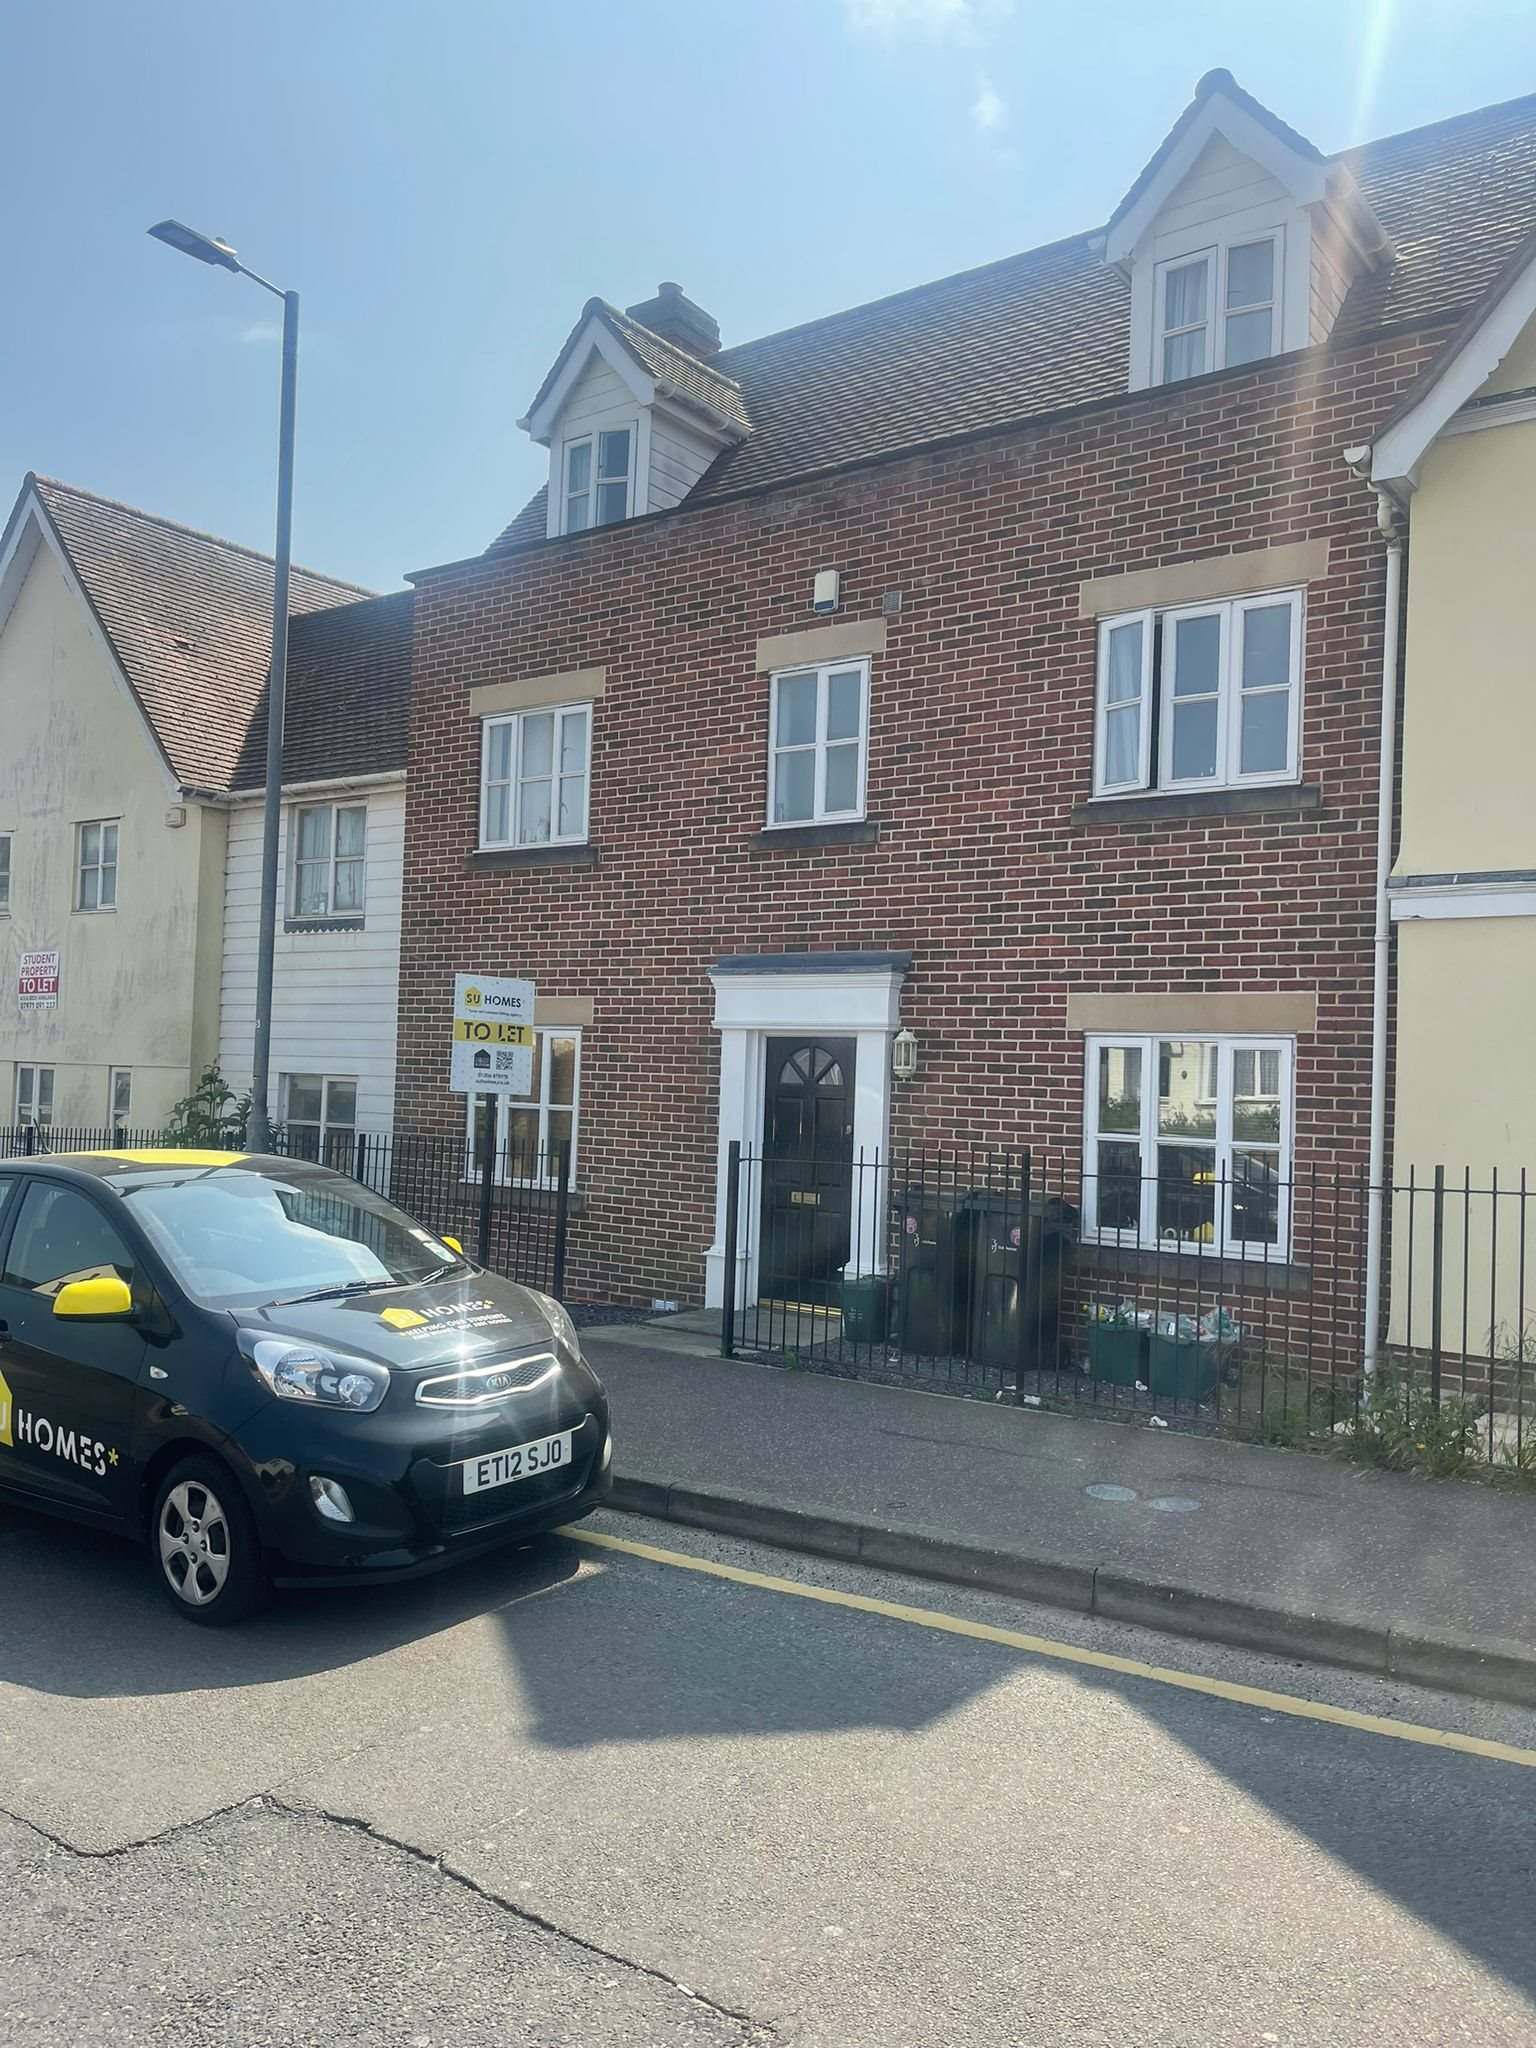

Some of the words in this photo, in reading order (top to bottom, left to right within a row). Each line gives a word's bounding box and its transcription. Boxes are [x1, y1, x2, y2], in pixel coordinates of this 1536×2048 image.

[24, 954, 56, 965] STUDENT
[21, 966, 57, 976] PROPERTY
[22, 979, 35, 993] TO
[37, 978, 55, 992] LET
[466, 993, 480, 1004] SU
[484, 996, 522, 1008] HOMES
[463, 1021, 491, 1041] TO
[498, 1024, 525, 1043] LET
[490, 1375, 509, 1388] KIA
[477, 1451, 522, 1487] ET12
[527, 1439, 562, 1472] SJO
